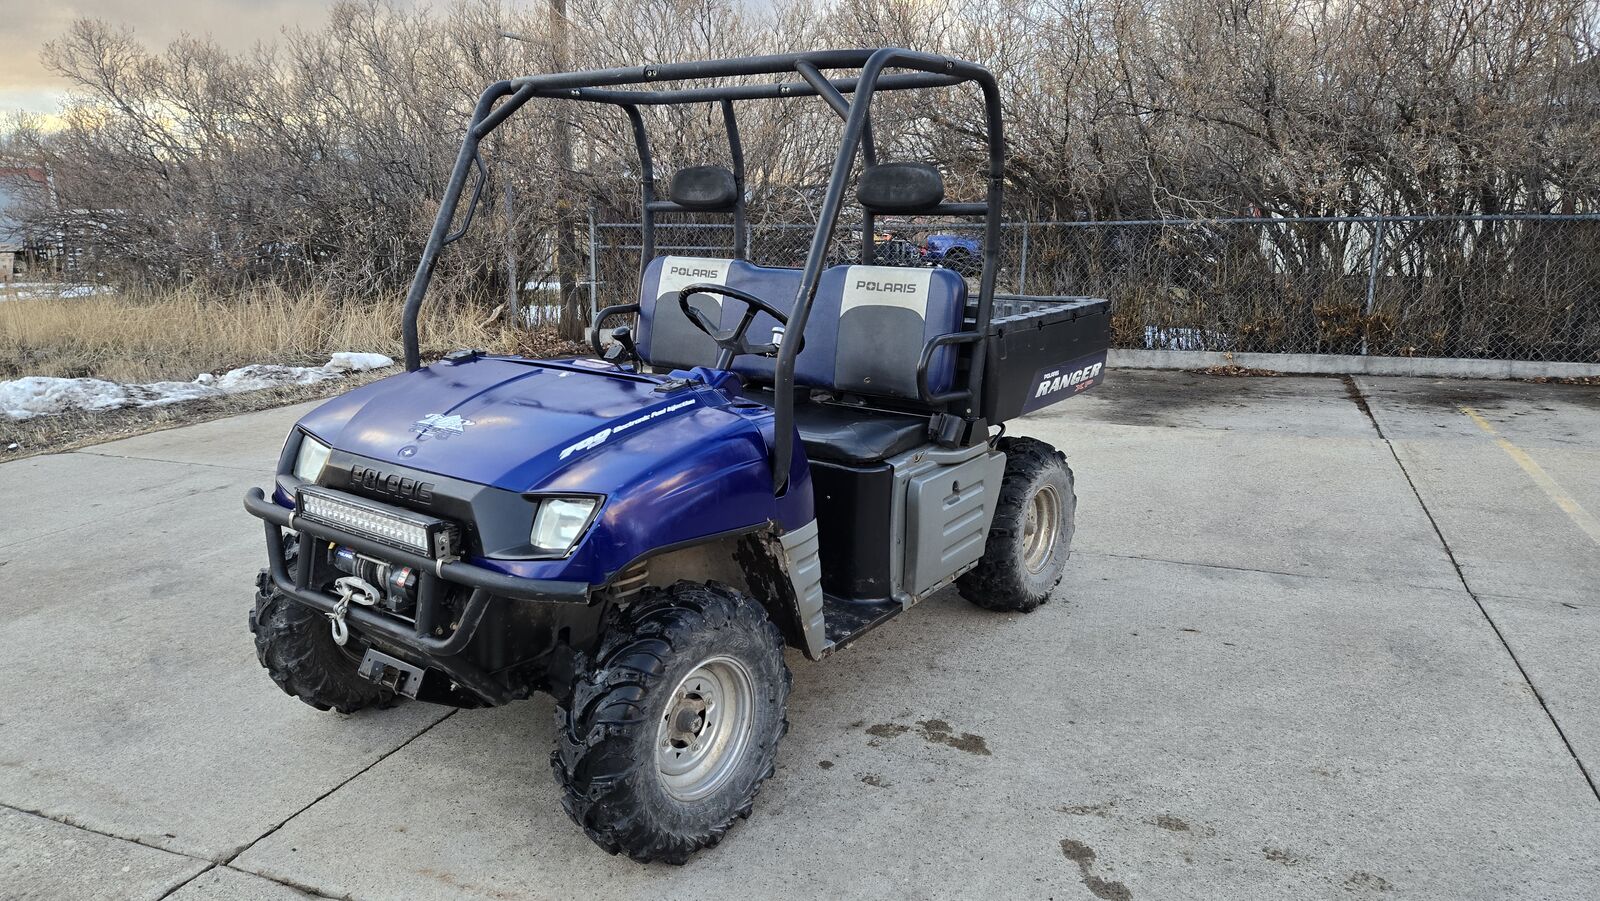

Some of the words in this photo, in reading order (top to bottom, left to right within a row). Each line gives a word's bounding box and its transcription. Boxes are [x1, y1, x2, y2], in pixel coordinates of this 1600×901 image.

[670, 266, 718, 279] POLARIS
[855, 280, 917, 294] POLARIS
[1034, 362, 1103, 398] RANGER
[1043, 370, 1060, 380] POLARIS
[1074, 379, 1094, 392] XP
[351, 464, 435, 505] POLARIS
